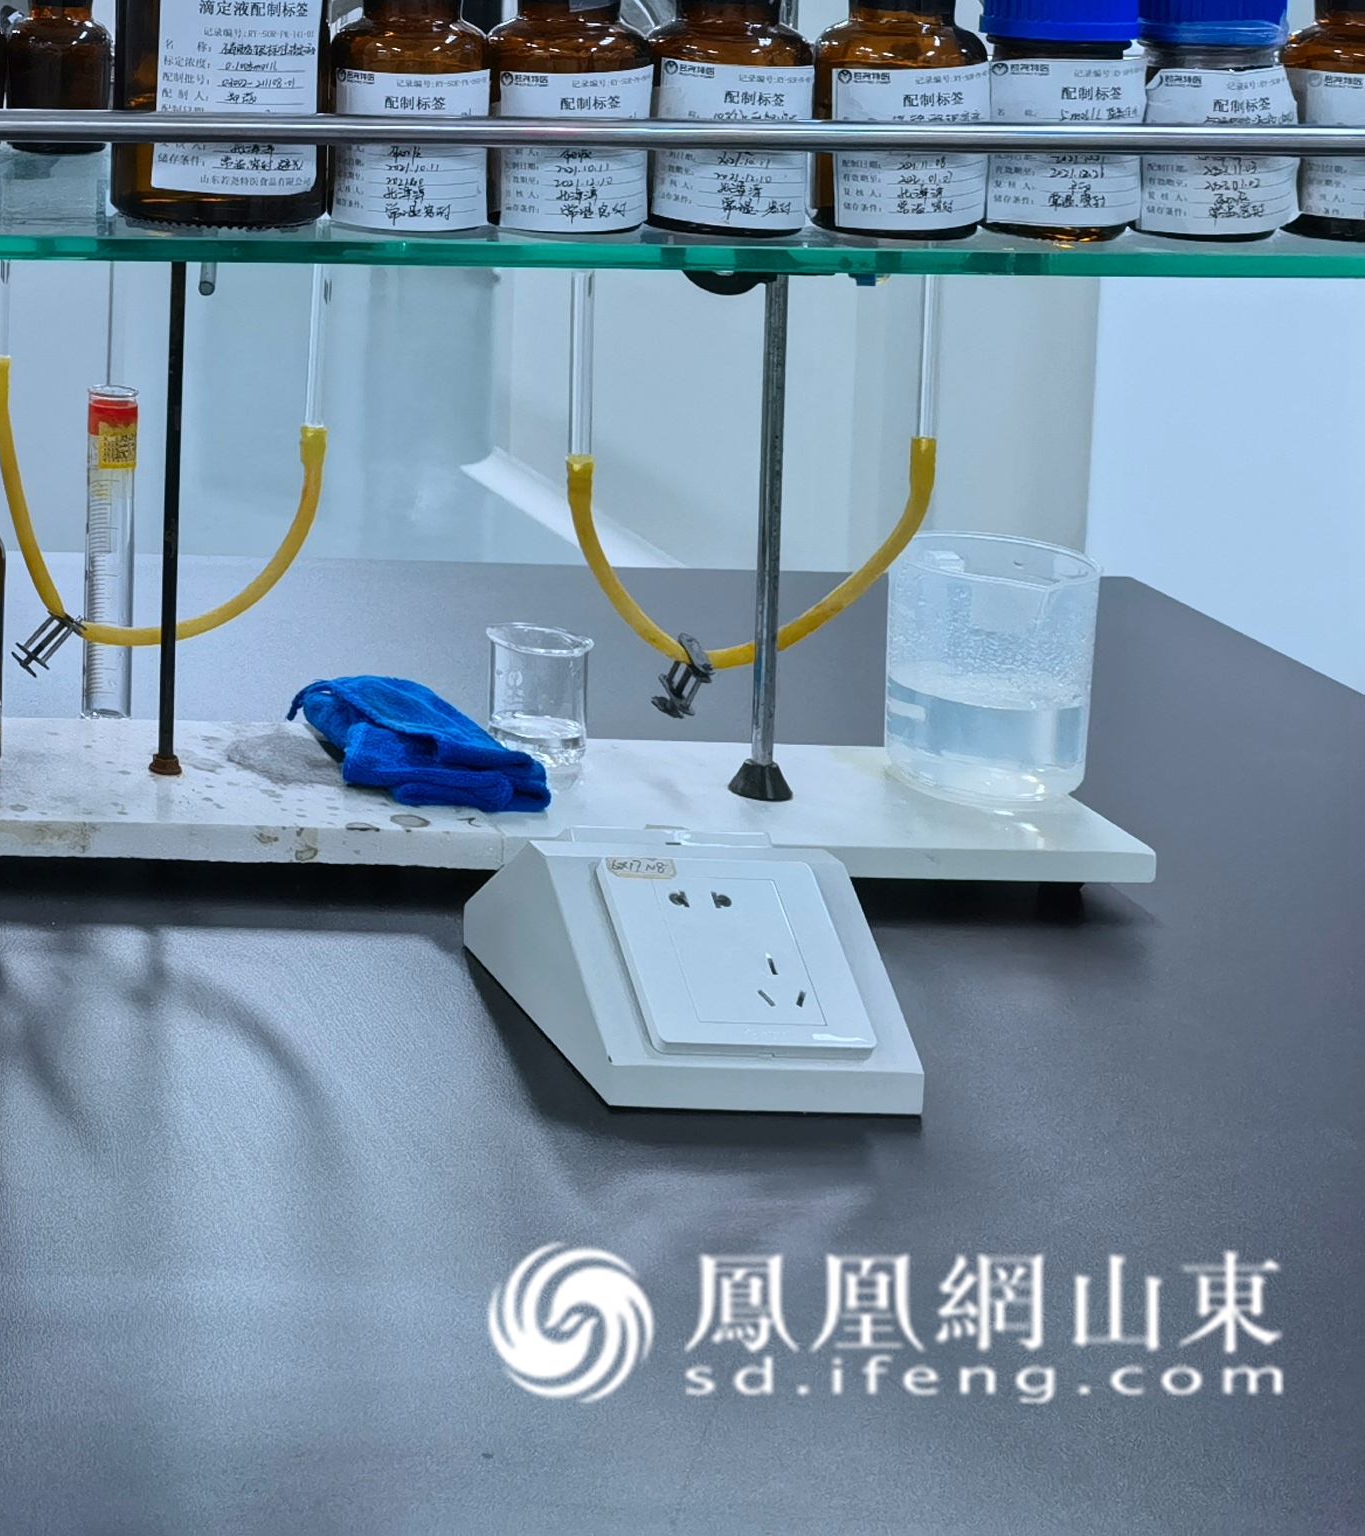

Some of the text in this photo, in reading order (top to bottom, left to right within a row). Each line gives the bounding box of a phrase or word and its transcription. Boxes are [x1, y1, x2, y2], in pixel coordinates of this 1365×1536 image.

[199, 0, 309, 17] 滴定液配制标签
[164, 55, 211, 69] 标定浓度:
[162, 72, 210, 86] 配制批号:
[723, 90, 785, 108] 配制标签
[903, 92, 964, 108] 配制标签
[1061, 86, 1122, 101] 配制标签
[384, 96, 446, 111] 配制标签
[560, 96, 621, 112] 配制标签
[1212, 97, 1272, 114] 配制标签
